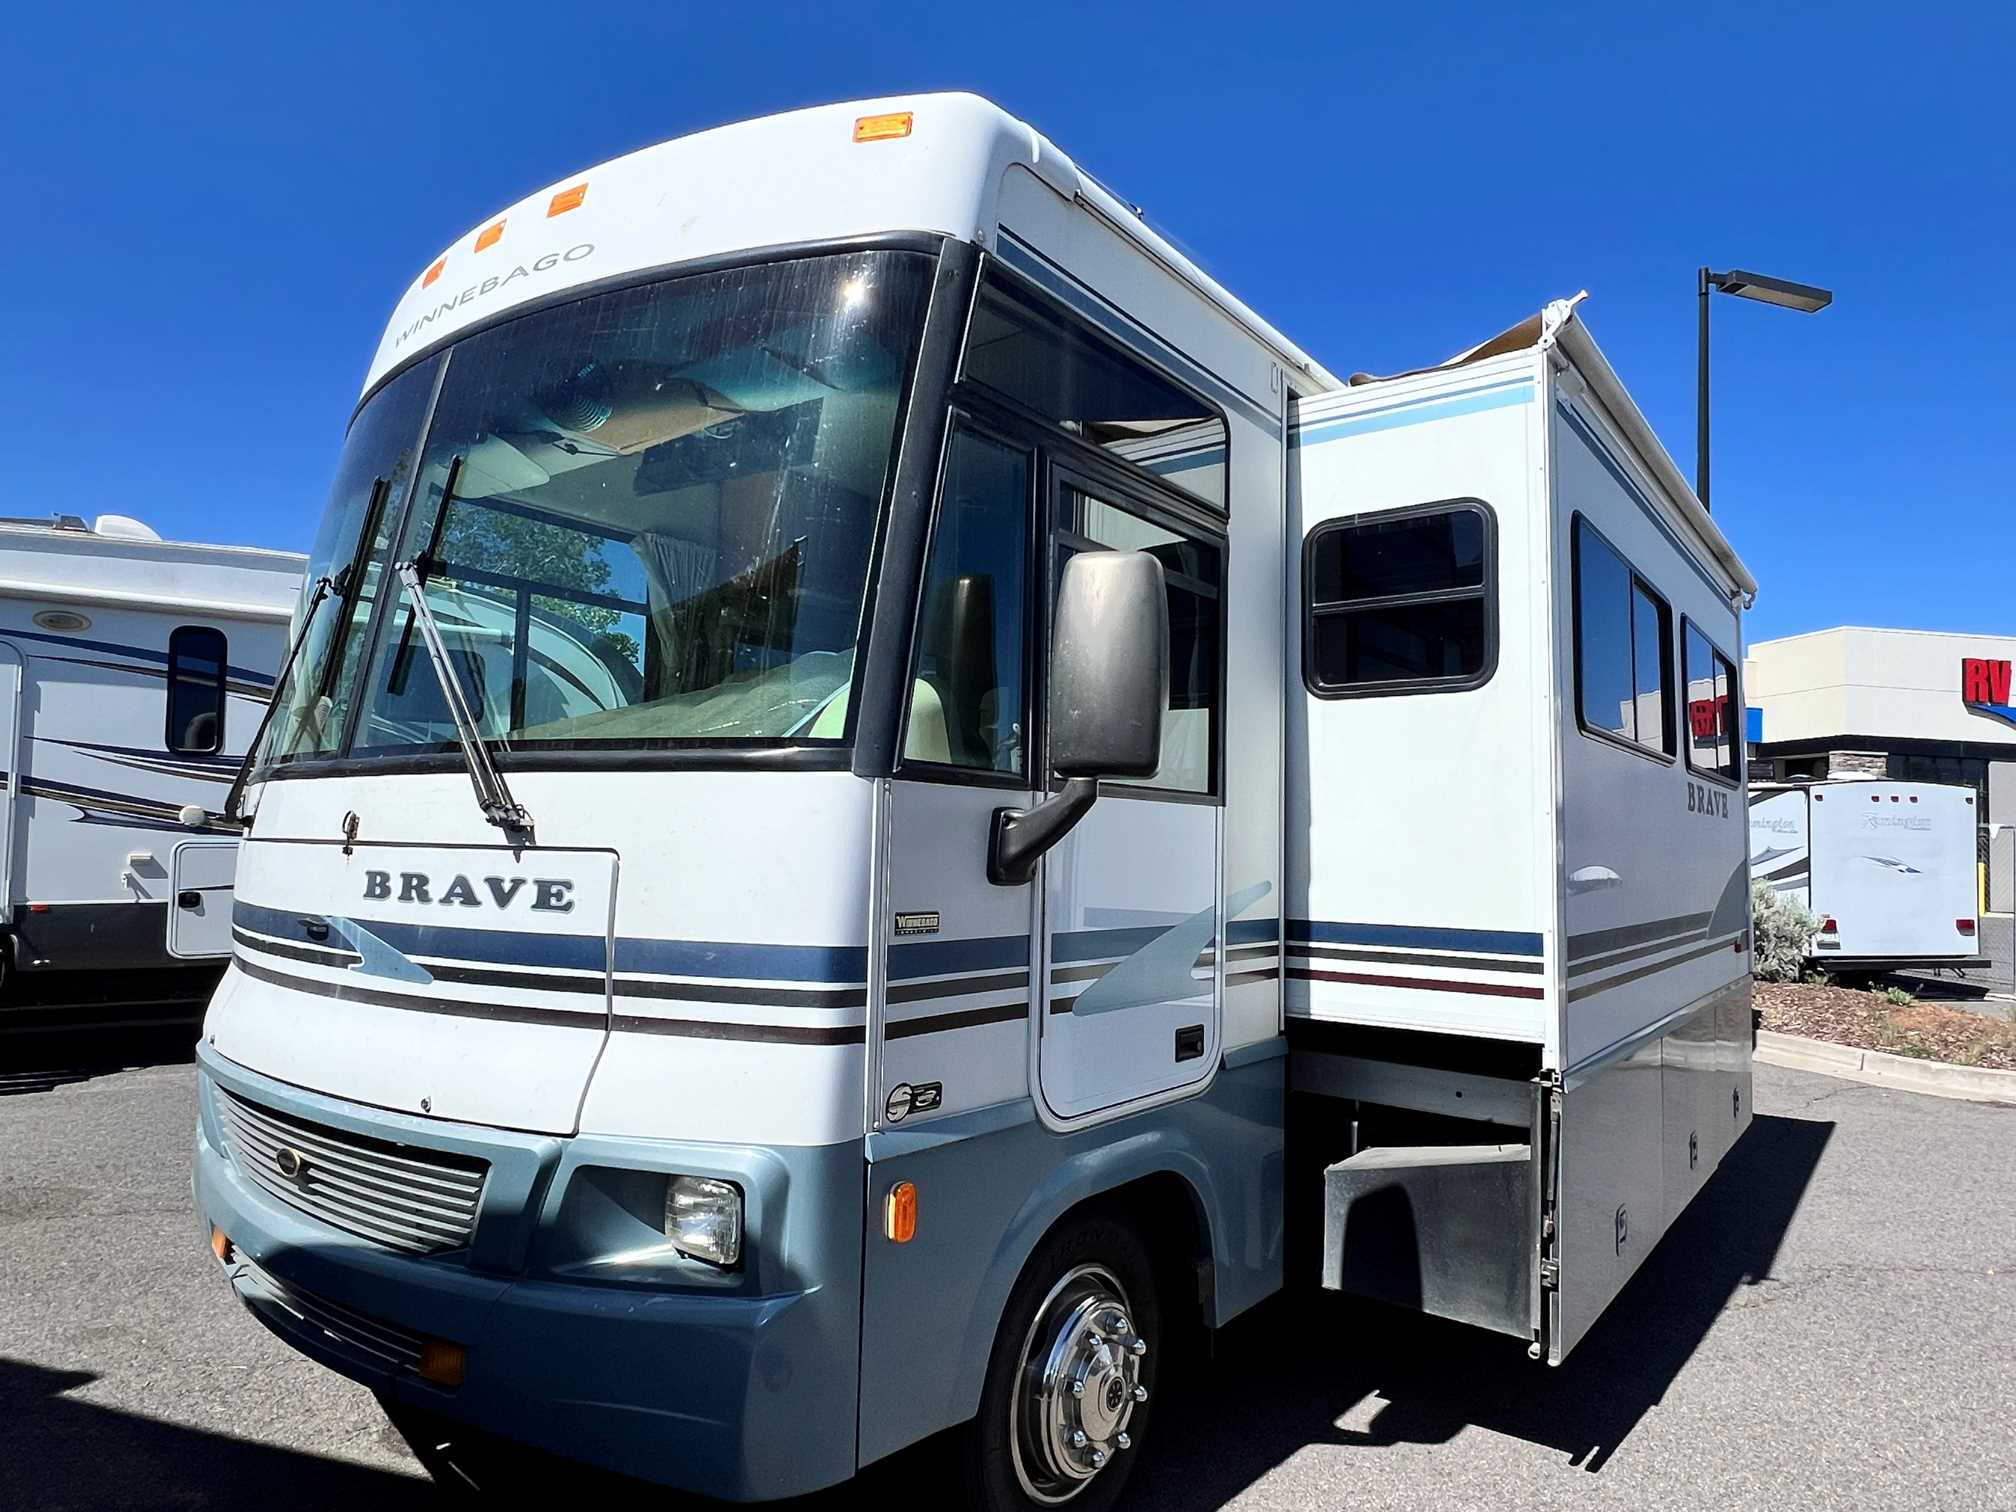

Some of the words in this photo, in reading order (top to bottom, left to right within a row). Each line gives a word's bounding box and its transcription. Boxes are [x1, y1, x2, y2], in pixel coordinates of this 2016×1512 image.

[395, 243, 595, 348] WINNEBAGO
[1962, 658, 2012, 704] RV
[1687, 781, 1729, 819] BRAVE
[362, 869, 577, 915] BRAVE
